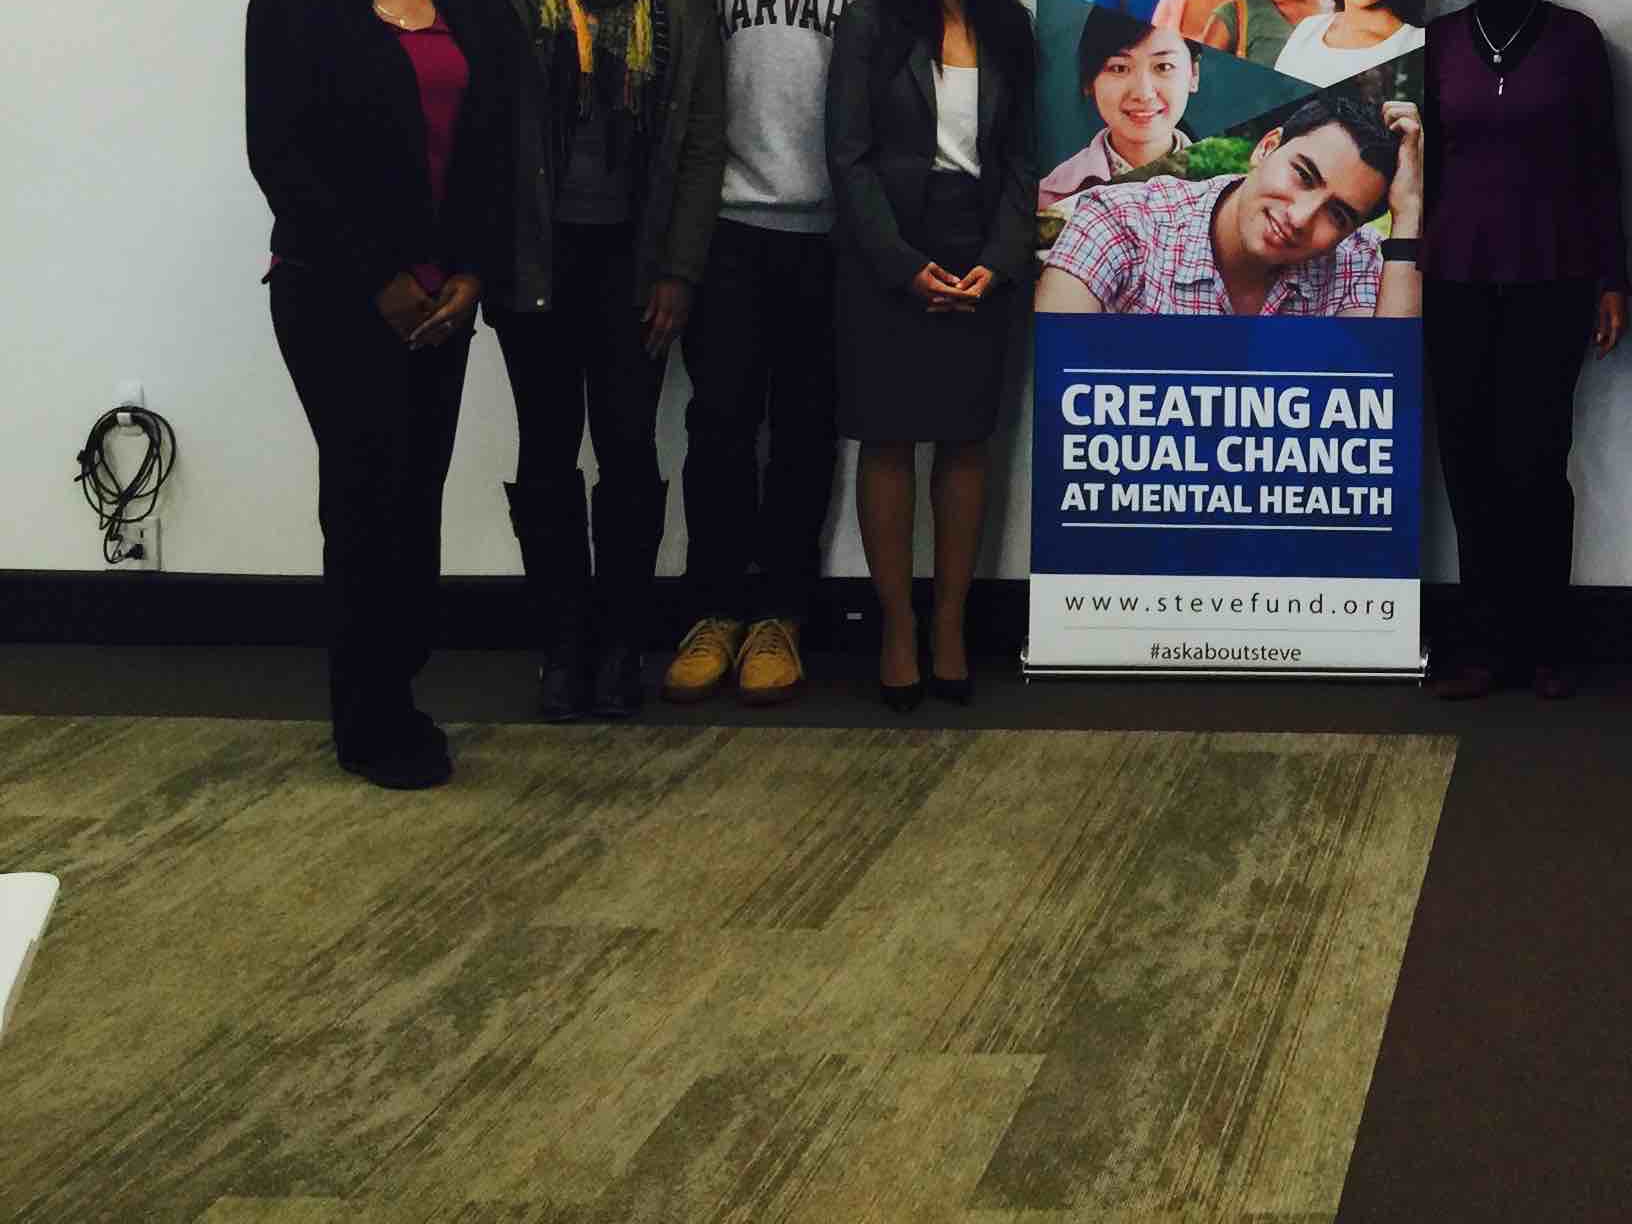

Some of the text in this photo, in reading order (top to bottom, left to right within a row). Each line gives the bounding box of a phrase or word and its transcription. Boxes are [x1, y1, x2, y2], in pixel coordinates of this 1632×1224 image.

[1061, 383, 1393, 430] CREATING AN
[1063, 434, 1393, 476] EQUAL CHANCE
[1060, 482, 1392, 516] AT MENTAL HEALTH
[1065, 593, 1396, 620] www.stevefund.org
[1149, 642, 1302, 662] #askaboutsteve
